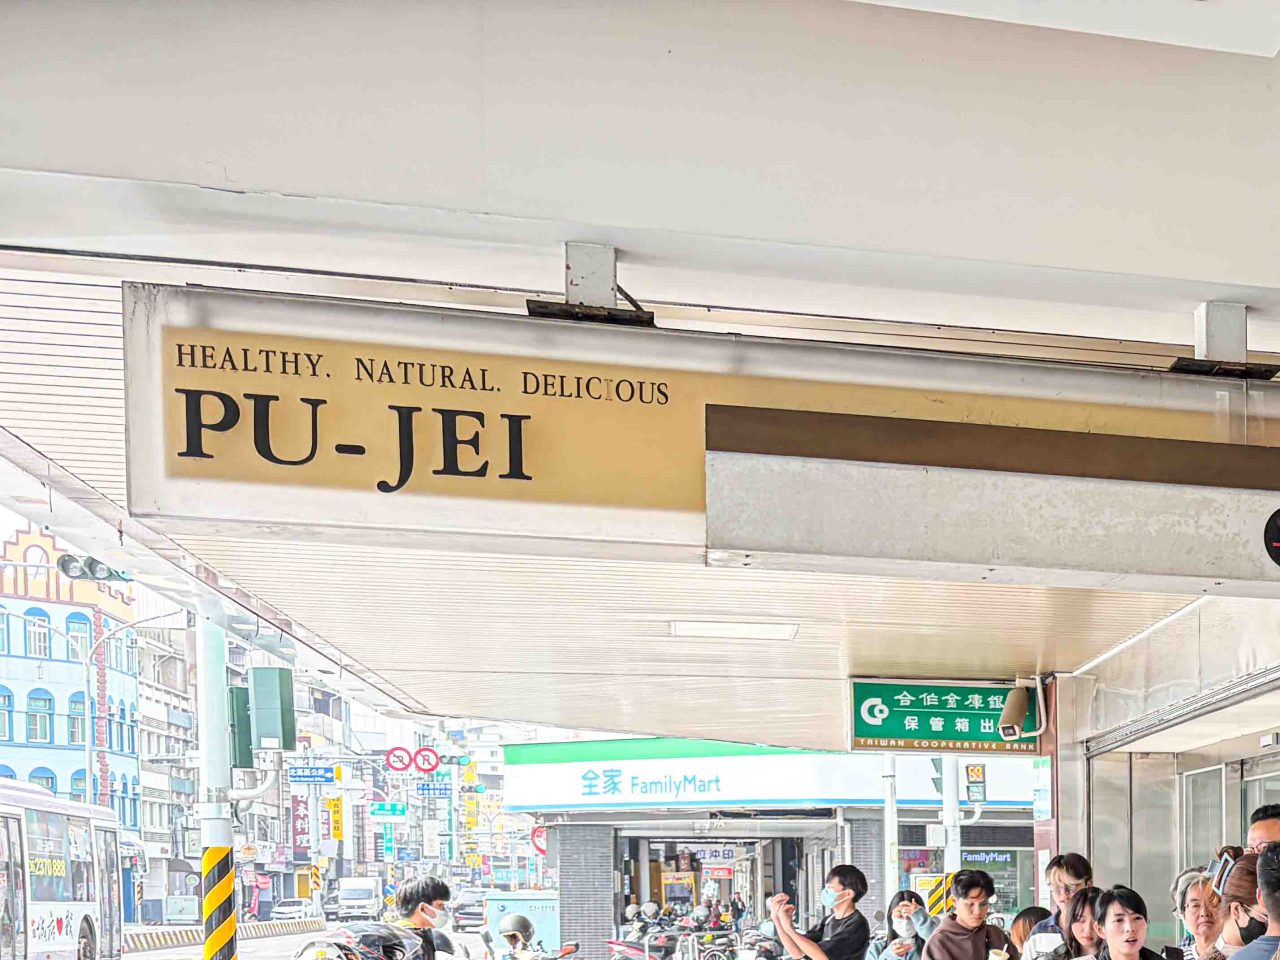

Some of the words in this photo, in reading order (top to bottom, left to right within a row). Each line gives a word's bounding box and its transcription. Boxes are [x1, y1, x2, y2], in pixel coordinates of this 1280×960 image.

[175, 343, 331, 378] HEALTHY.
[354, 357, 501, 393] NATURAL.
[521, 371, 669, 406] DELICIOUS
[174, 387, 533, 493] PU-JEI
[903, 715, 995, 733] 保管箱出
[859, 738, 905, 748] TAIWAN
[913, 741, 997, 750] COOPERATIVE
[581, 768, 623, 796] 全家
[630, 775, 722, 798] FamilyMart
[961, 852, 1012, 864] FamilyMart
